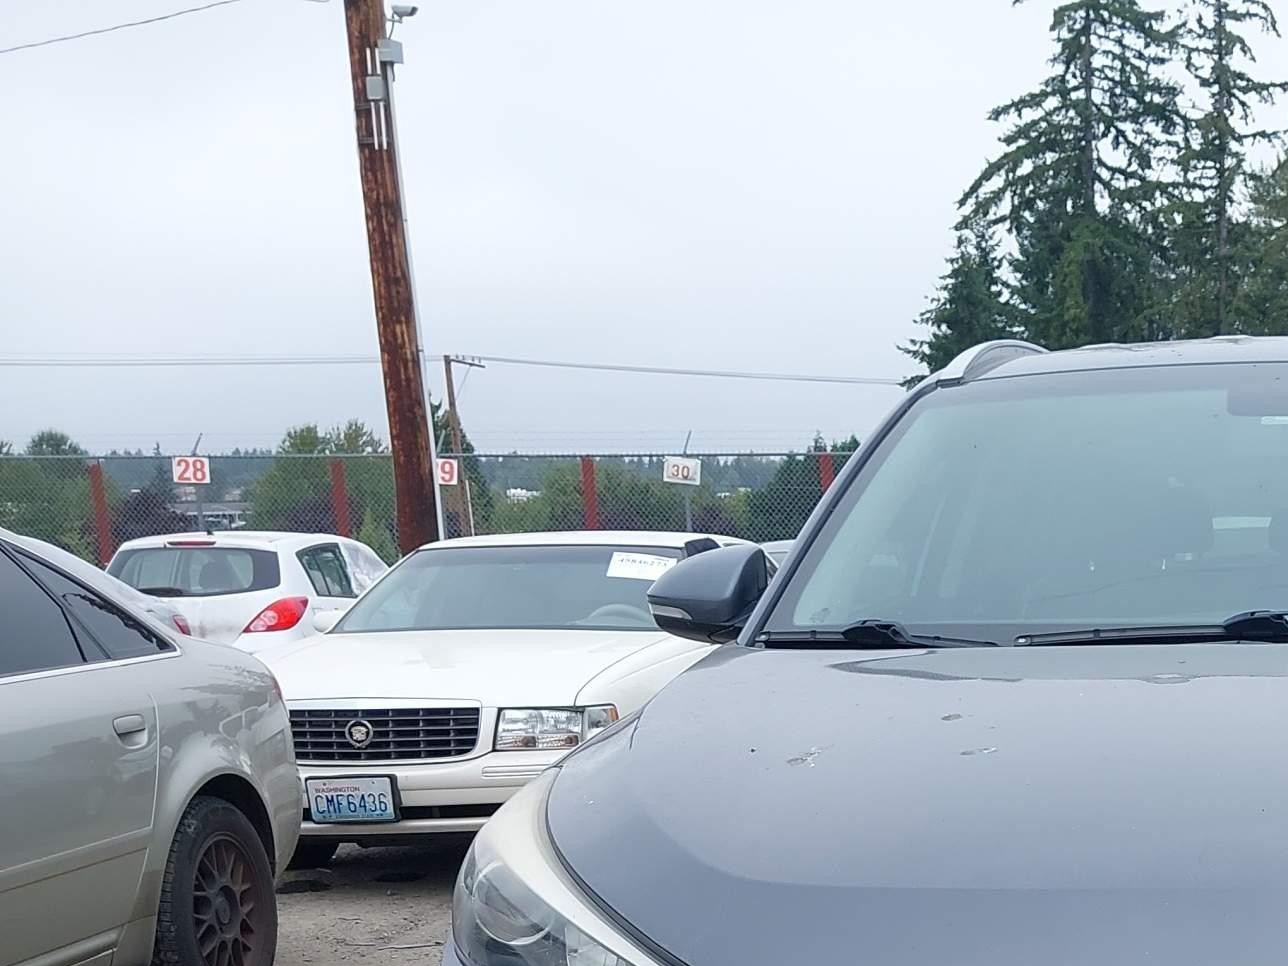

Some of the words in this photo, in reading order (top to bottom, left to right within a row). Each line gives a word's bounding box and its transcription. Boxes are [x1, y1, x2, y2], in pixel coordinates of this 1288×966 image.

[176, 459, 206, 482] 28
[671, 464, 690, 479] 30
[314, 786, 361, 794] WASHINGTON
[314, 793, 389, 815] CMF6436
